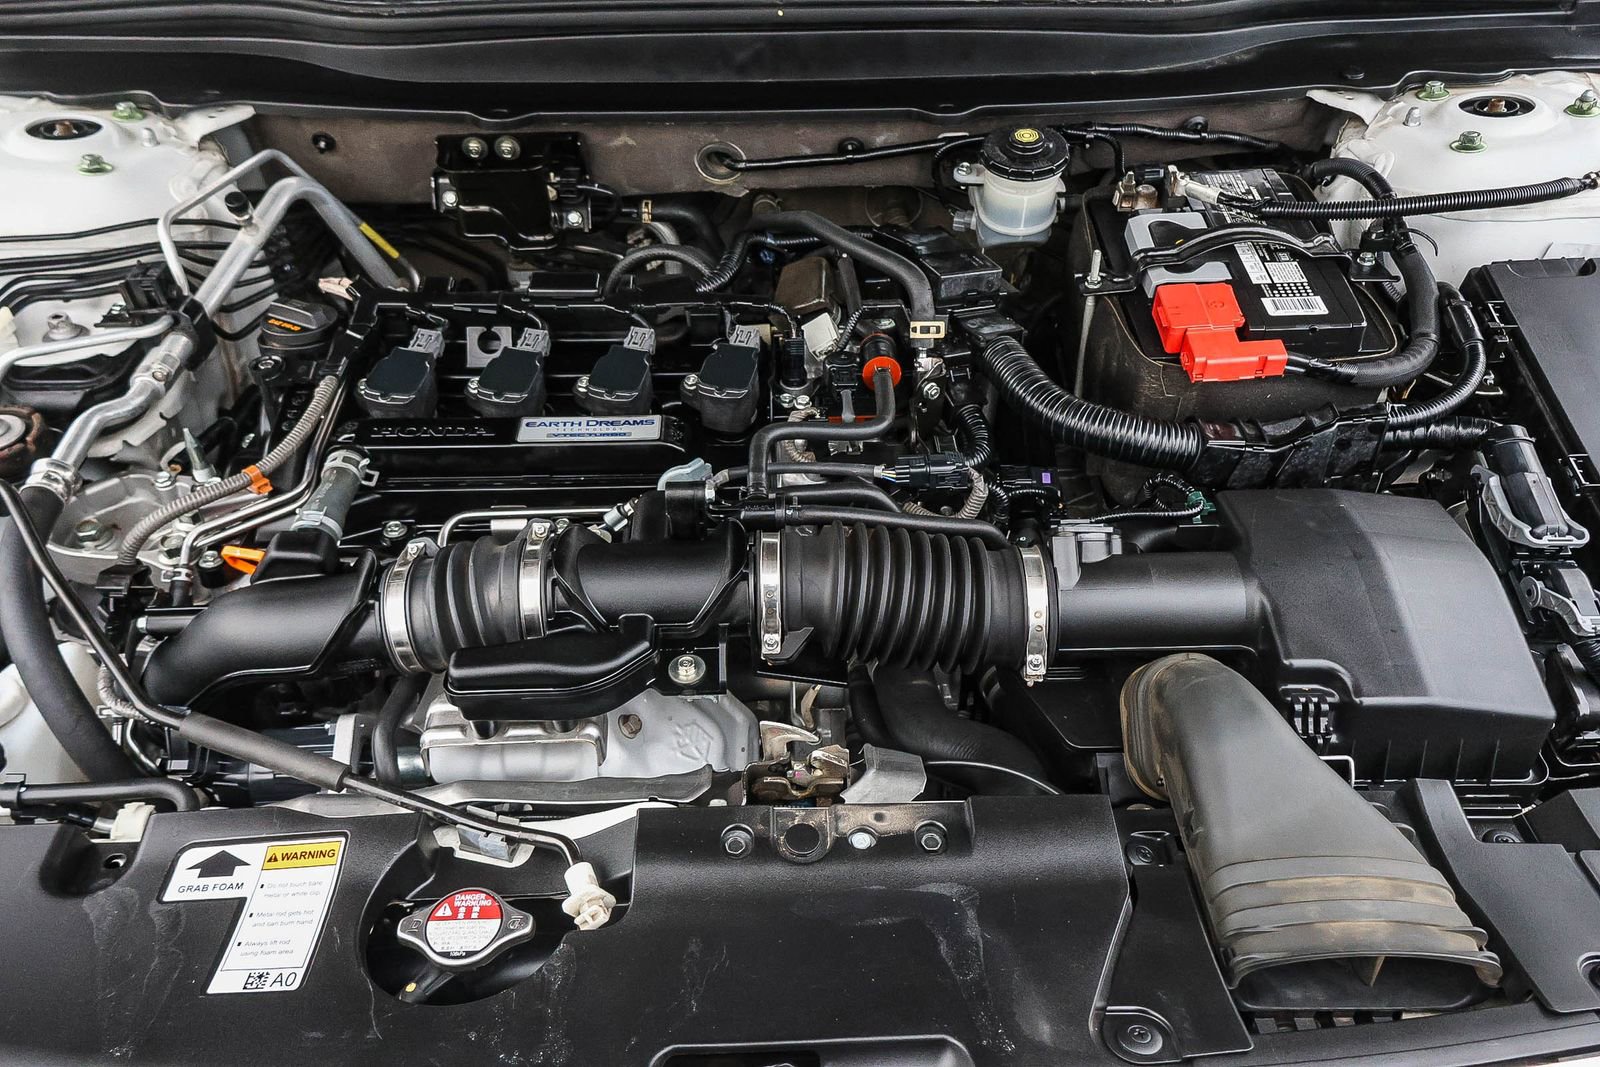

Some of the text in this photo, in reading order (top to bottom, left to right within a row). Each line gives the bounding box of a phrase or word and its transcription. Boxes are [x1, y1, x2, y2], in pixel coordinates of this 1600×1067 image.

[586, 418, 655, 427] DREAMS
[371, 426, 495, 438] HONDA
[281, 848, 336, 862] WARNING
[178, 882, 244, 893] GRAB FOAM
[269, 972, 298, 988] A0
